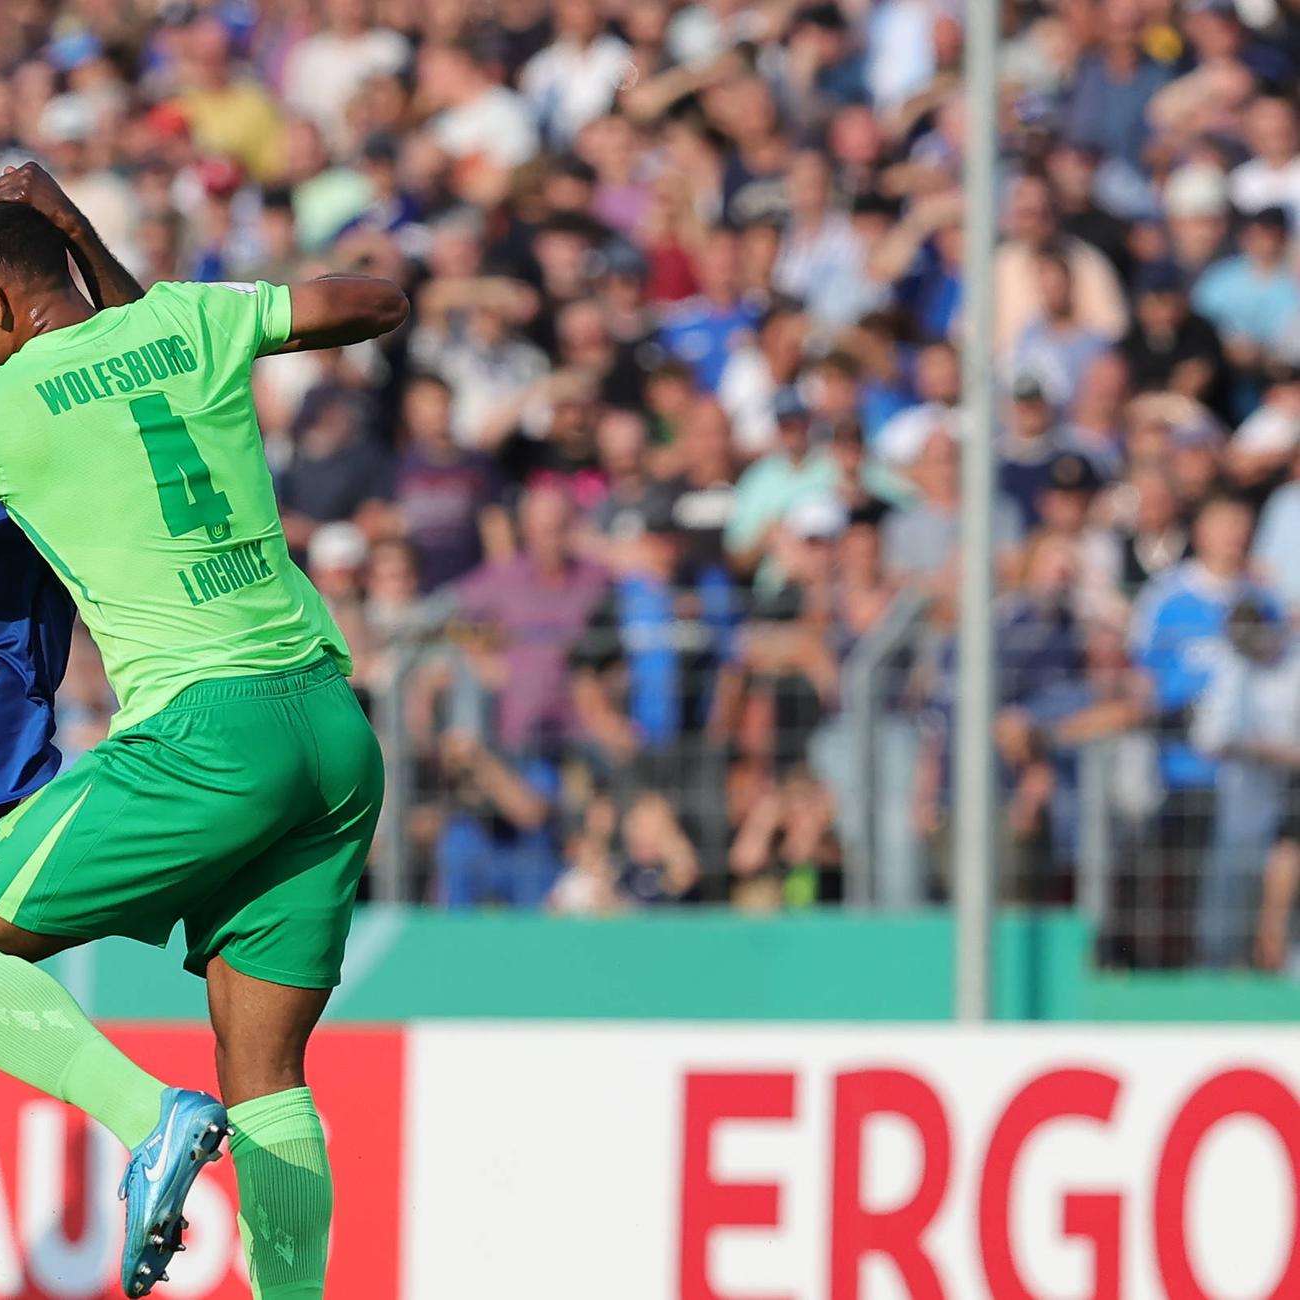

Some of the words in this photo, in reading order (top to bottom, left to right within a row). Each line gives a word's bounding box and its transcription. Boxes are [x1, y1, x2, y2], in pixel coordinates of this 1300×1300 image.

[35, 334, 198, 416] WOLFSBURG
[129, 391, 234, 543] 4
[177, 540, 274, 606] LACROIX
[677, 1068, 1300, 1300] ERGO
